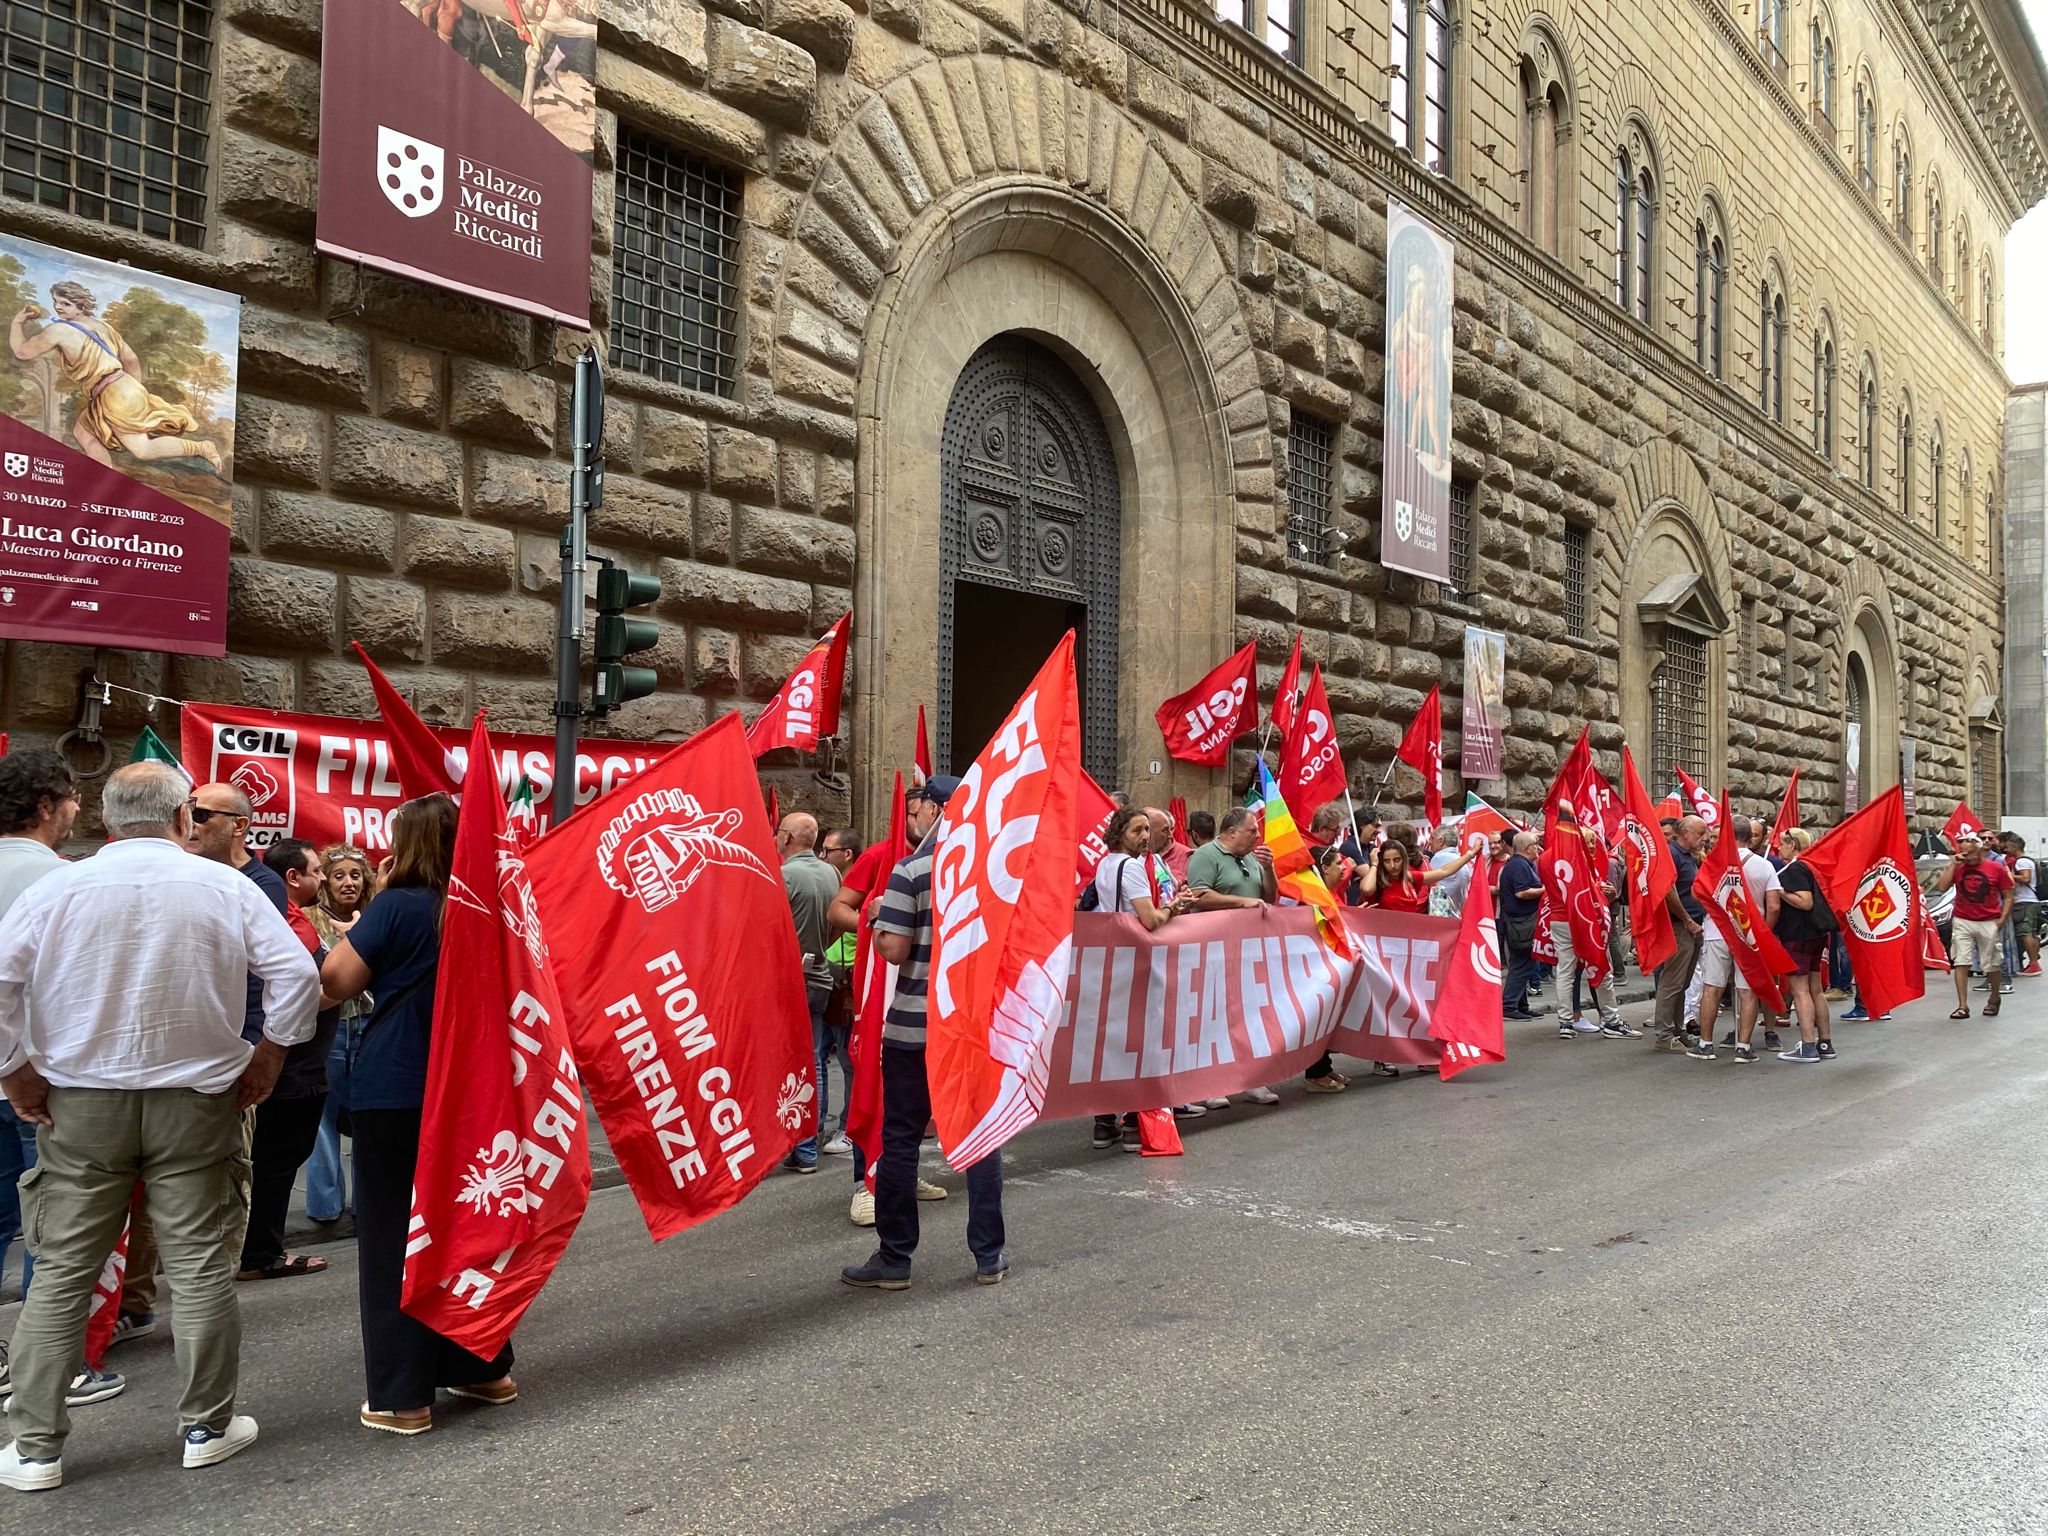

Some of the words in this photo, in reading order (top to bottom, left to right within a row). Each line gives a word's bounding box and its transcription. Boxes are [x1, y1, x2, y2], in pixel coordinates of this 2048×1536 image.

[458, 157, 542, 206] Palazzo
[460, 186, 539, 232] Medici
[454, 211, 543, 259] Riccardi
[31, 472, 65, 485] Riccardi
[33, 457, 65, 469] Palazzo
[34, 466, 63, 477] Medici
[3, 491, 18, 501] 30
[20, 493, 67, 509] MARZO
[81, 502, 89, 512] 5
[90, 503, 158, 522] SETTEMBRE
[160, 513, 185, 526] 2023
[1415, 508, 1438, 525] Palazzo
[1, 516, 63, 543] Luca
[71, 526, 184, 558] Giordano
[1414, 535, 1437, 552] Riccardi
[1416, 522, 1437, 538] Medici
[1, 541, 60, 559] Maestro
[64, 548, 119, 566] barocco
[122, 558, 132, 567] a
[135, 557, 182, 573] Firenze
[786, 669, 815, 739] CGIL
[219, 728, 291, 754] CGIL
[628, 849, 668, 907] FIOM
[935, 761, 989, 1019] CGIL
[645, 950, 717, 1060] FIOM
[698, 1066, 755, 1182] CGIL
[604, 993, 708, 1190] FIRENZE
